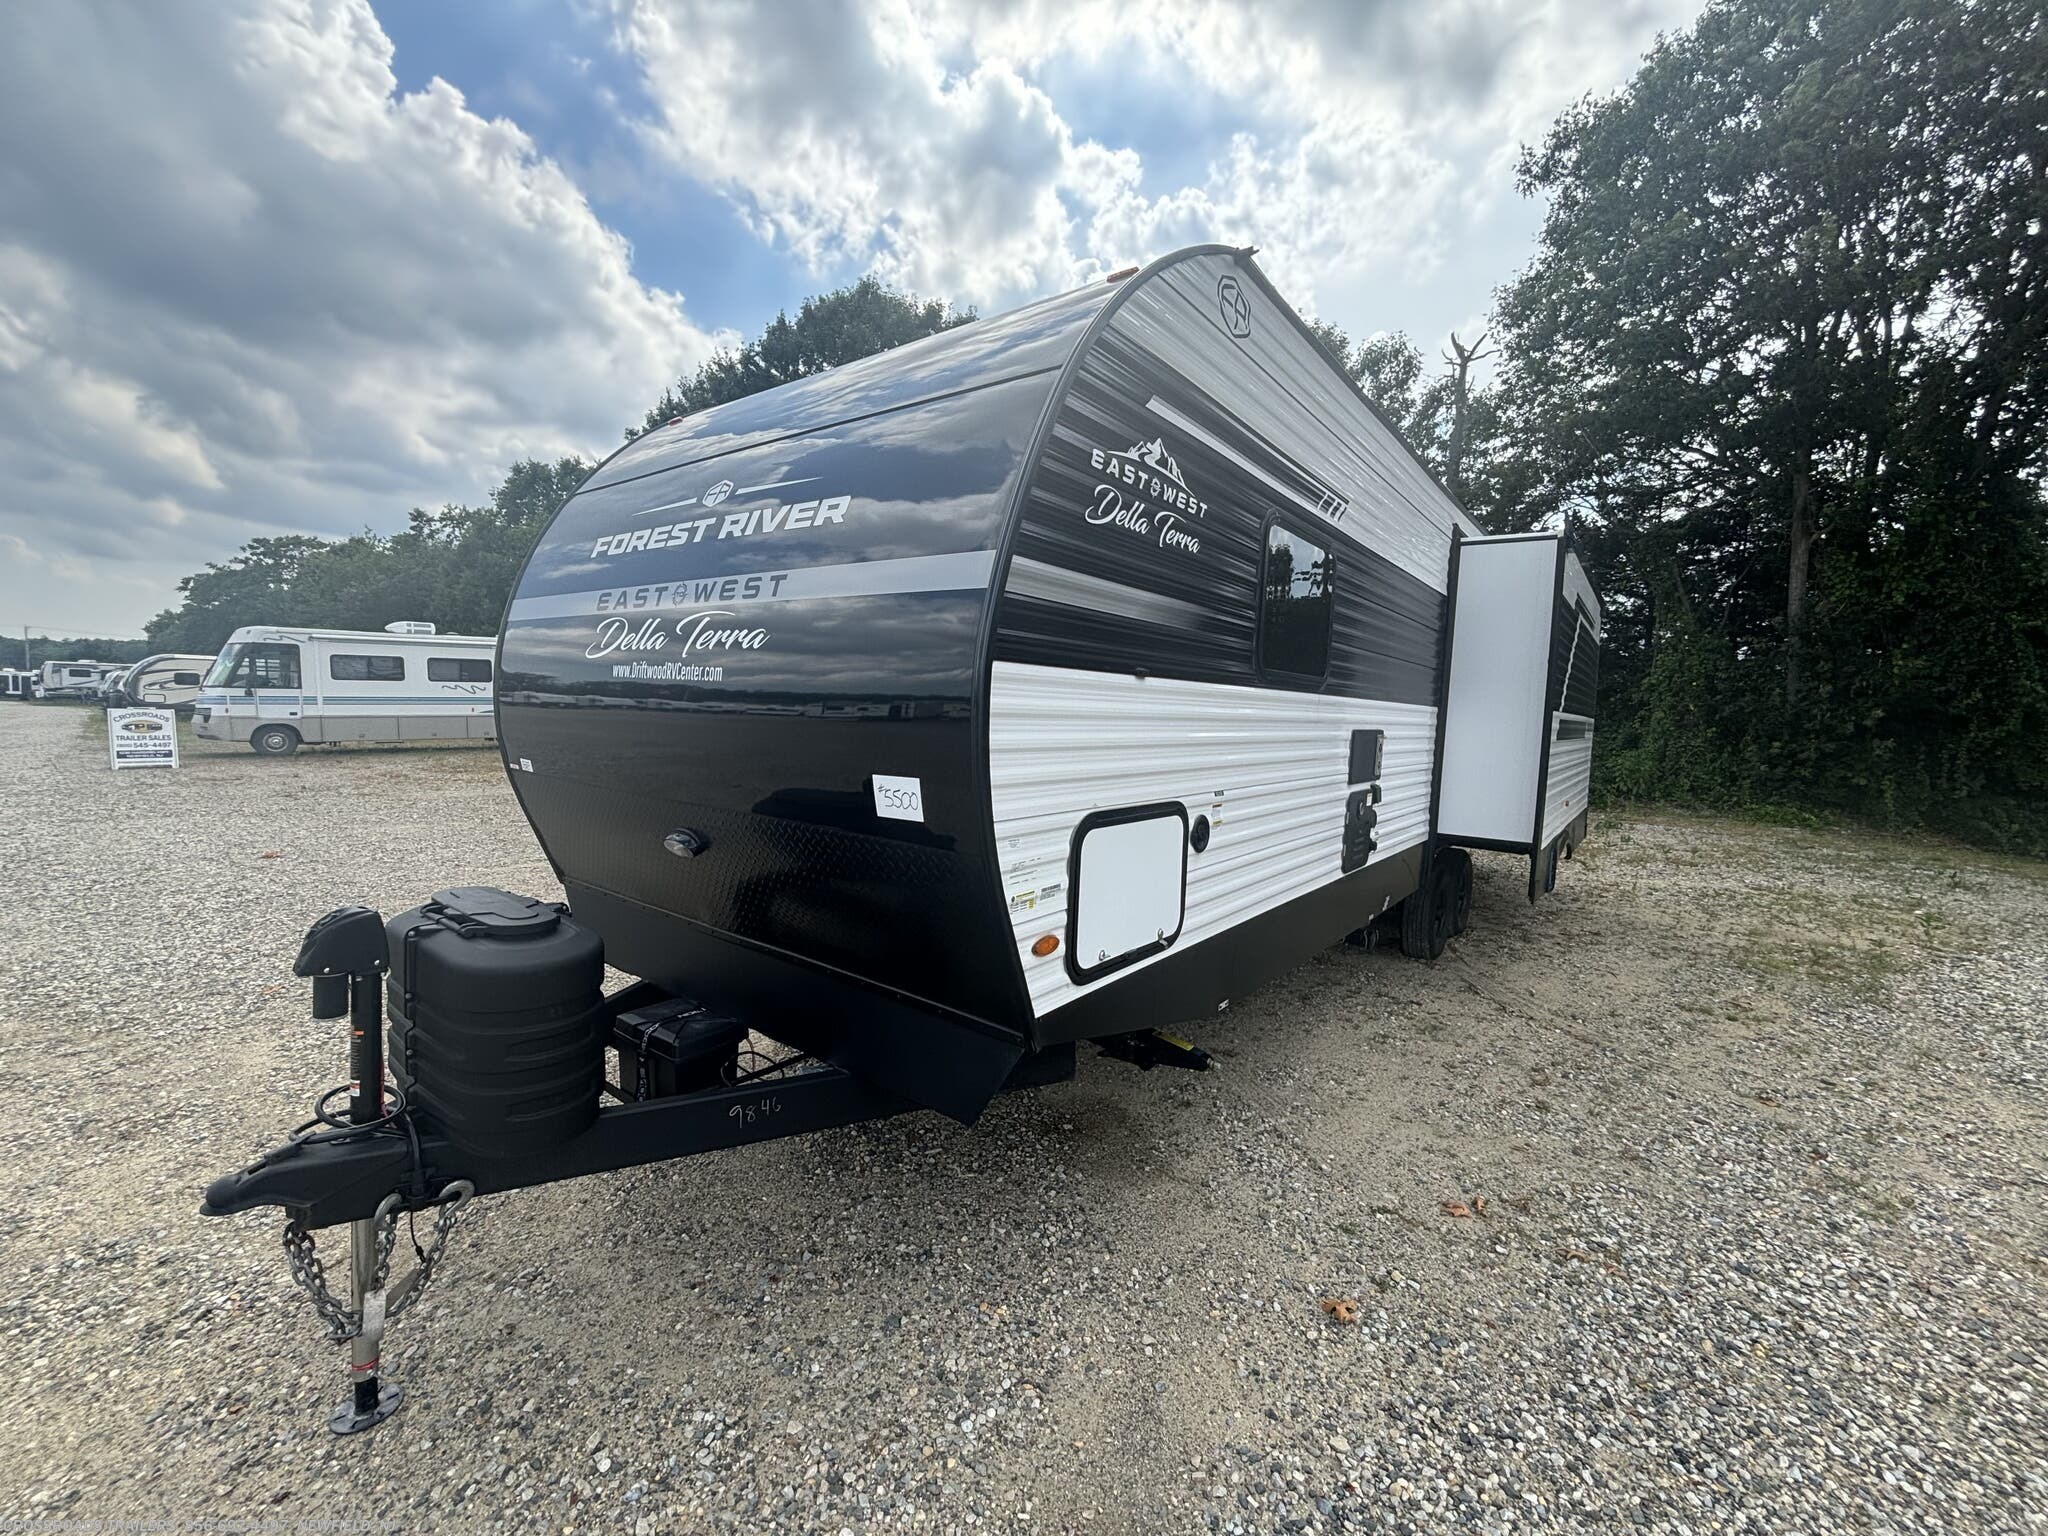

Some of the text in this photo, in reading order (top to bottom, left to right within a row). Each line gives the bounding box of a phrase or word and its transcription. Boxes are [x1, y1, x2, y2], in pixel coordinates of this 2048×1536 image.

[1091, 448, 1208, 518] EAST WEST
[590, 495, 852, 558] FOREST RIVER
[1085, 484, 1200, 553] Della Terra
[597, 586, 669, 611] EAST
[694, 574, 788, 603] WEST
[585, 610, 771, 659] Della Terra
[612, 661, 723, 682] www.DriftwoodRVCenter.com
[113, 711, 170, 722] CROSSROADS
[729, 1096, 781, 1129] 9846
